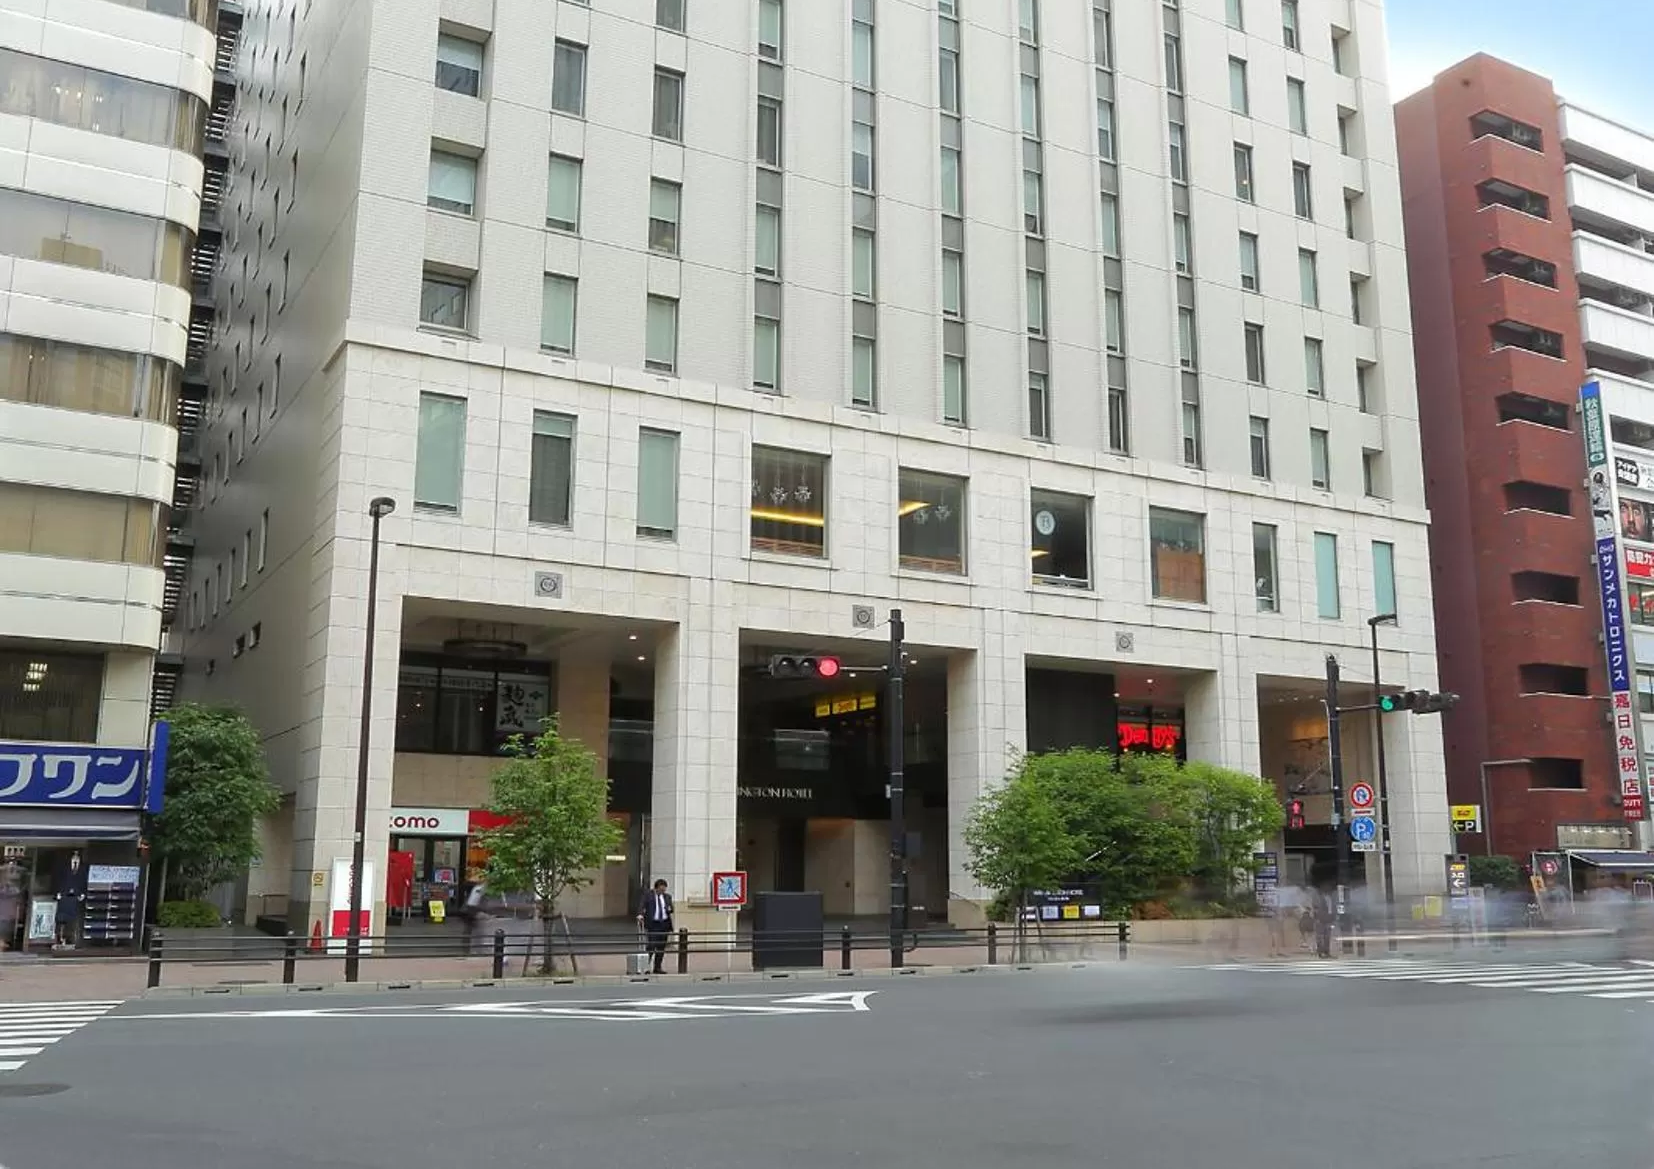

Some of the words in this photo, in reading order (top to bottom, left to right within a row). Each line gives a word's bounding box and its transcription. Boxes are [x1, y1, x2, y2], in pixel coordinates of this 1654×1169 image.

[1602, 554, 1626, 681] サンメカトロニクス
[389, 815, 440, 829] omo
[1464, 821, 1474, 832] P
